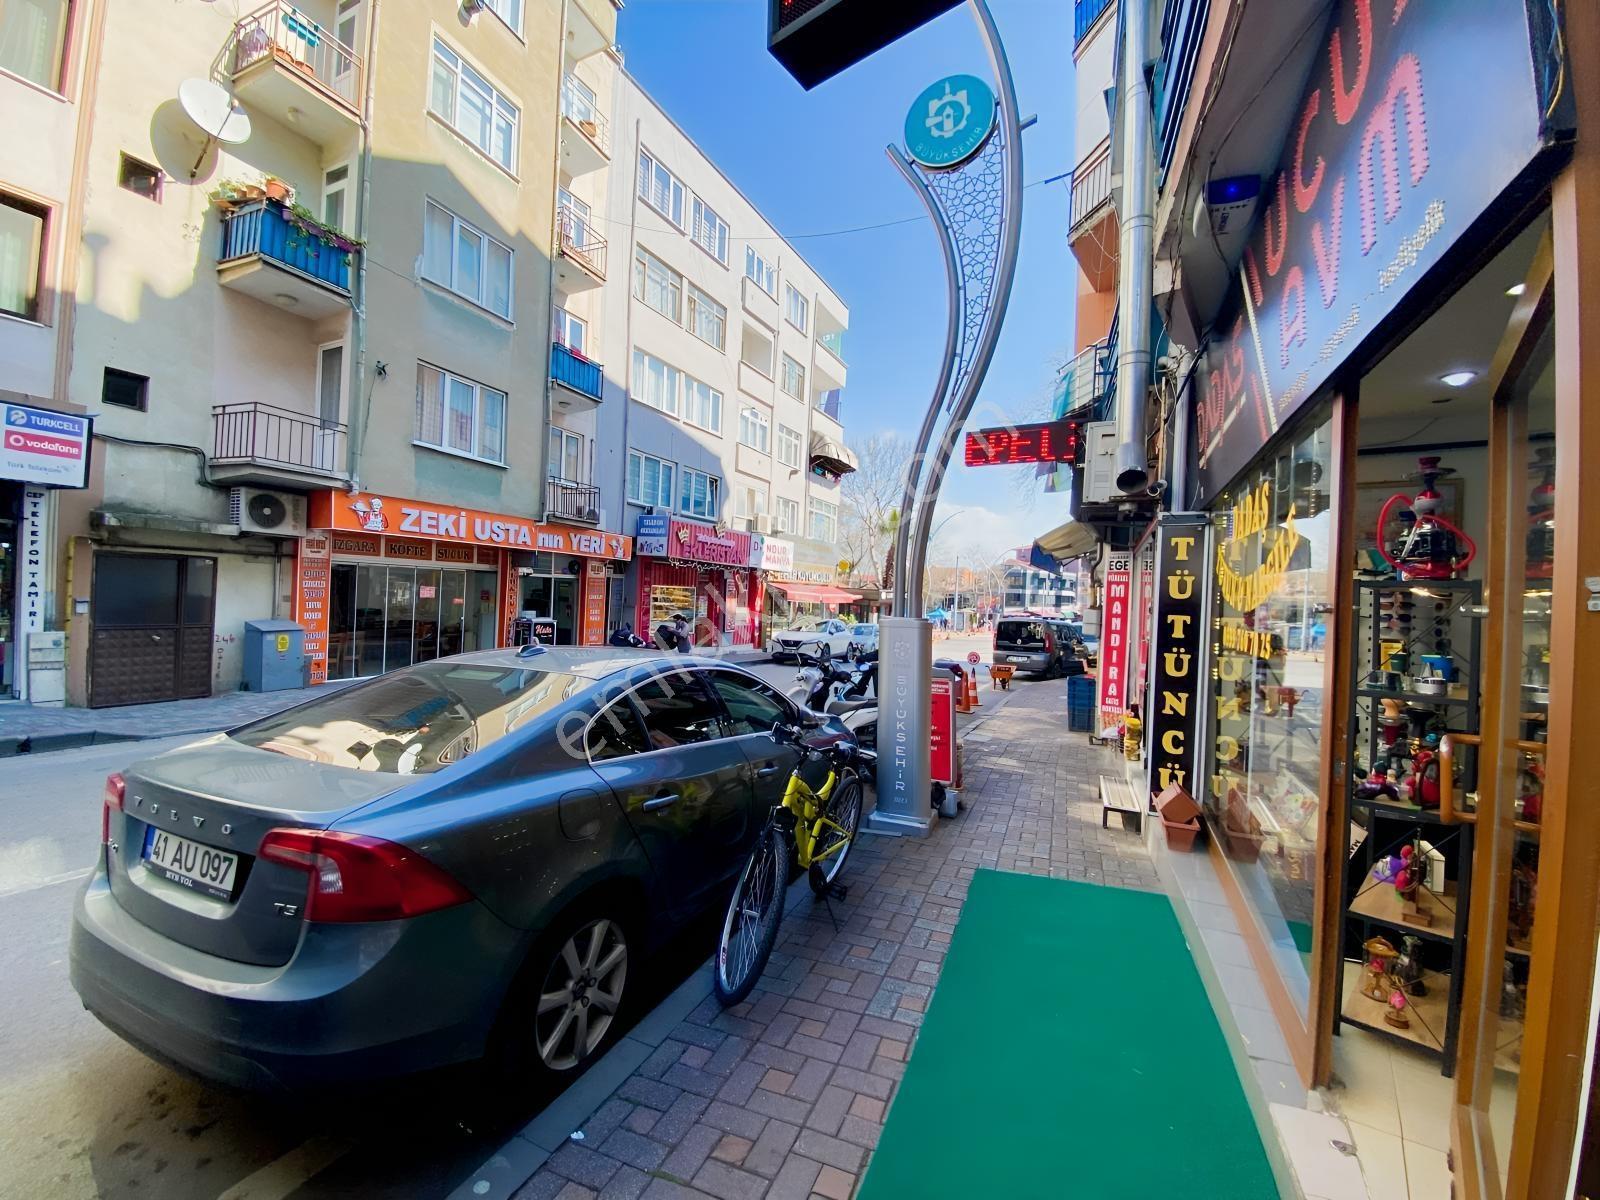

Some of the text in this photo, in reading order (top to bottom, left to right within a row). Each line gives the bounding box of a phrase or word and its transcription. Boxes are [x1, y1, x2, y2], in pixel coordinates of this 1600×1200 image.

[1279, 52, 1430, 371] AVM
[26, 440, 79, 455] vodafone
[30, 415, 81, 432] TURKCELL
[28, 501, 39, 565] TELEFON
[400, 506, 466, 539] ZEKİ
[569, 531, 606, 555] YERİ
[1109, 560, 1129, 571] EGE
[1108, 584, 1125, 697] MANDIRA
[1158, 536, 1195, 790] TÜTÜNCÜ
[133, 795, 233, 836] VOLVO
[153, 833, 234, 885] 41 AU 097
